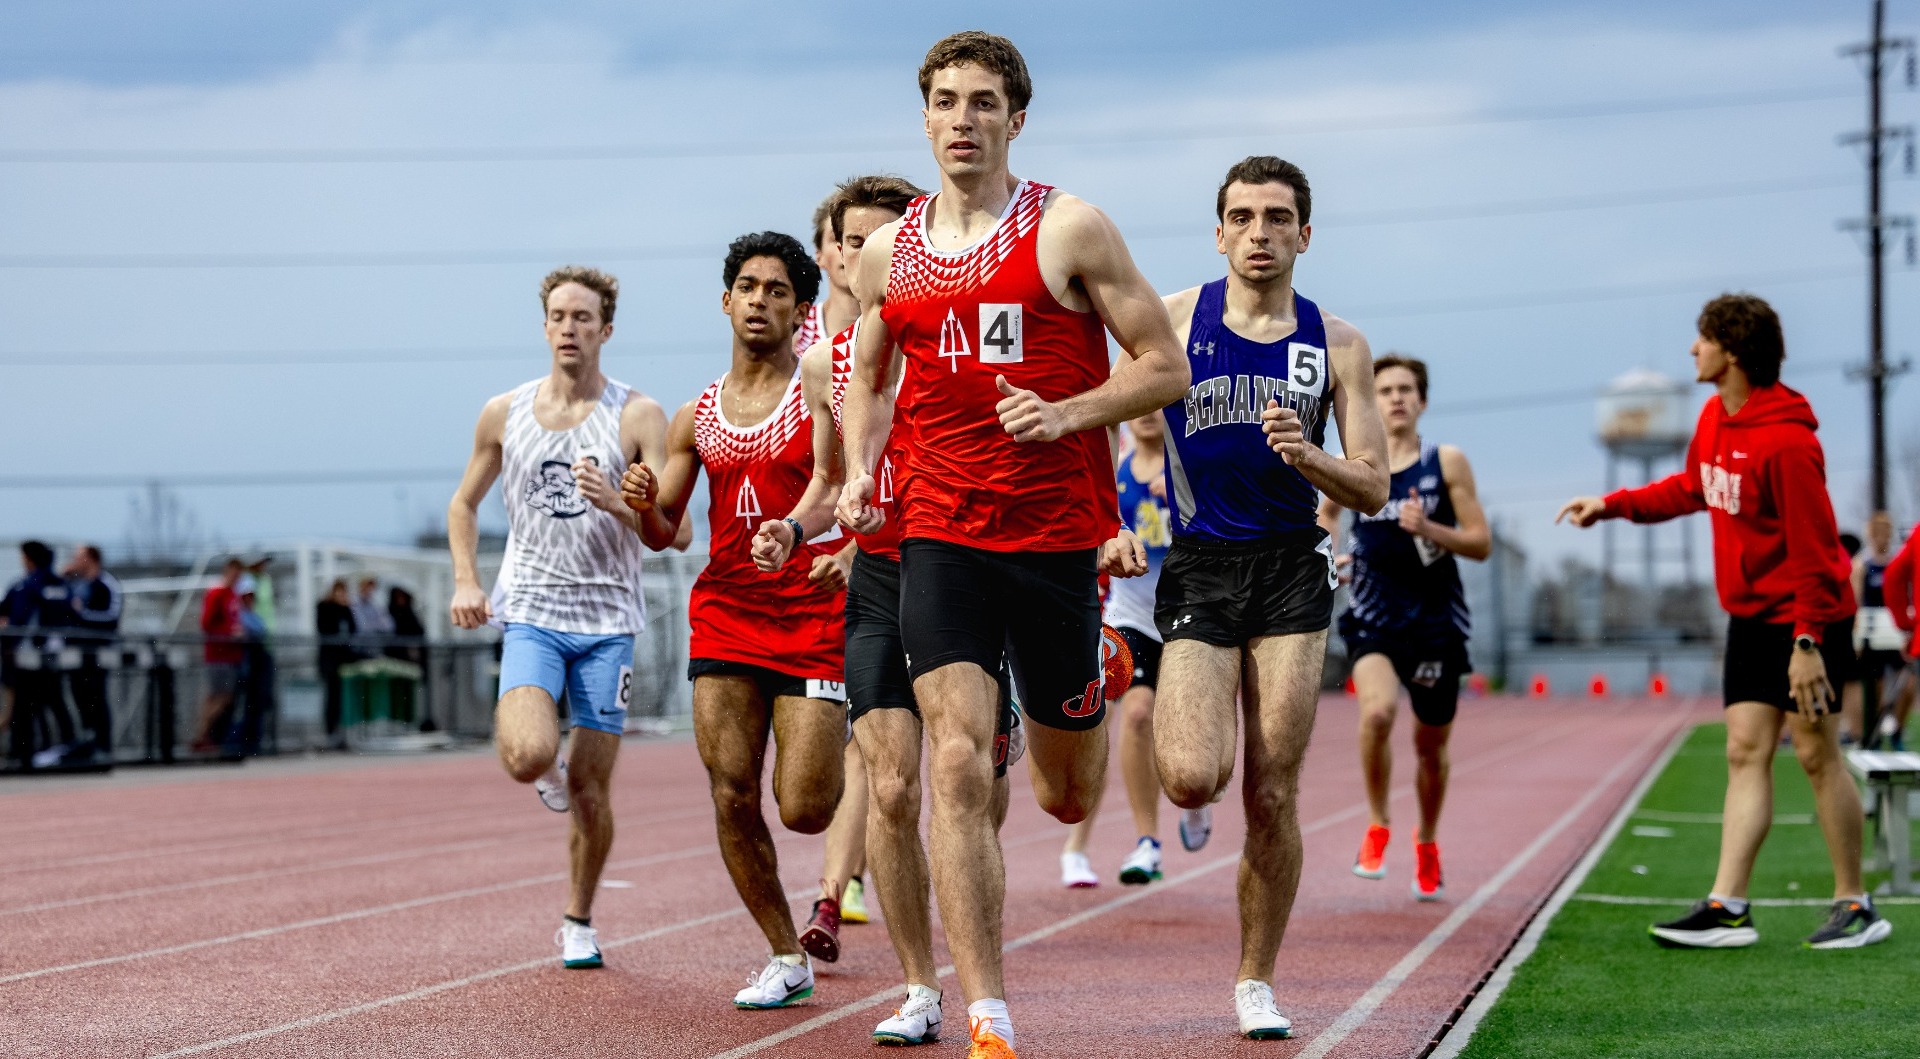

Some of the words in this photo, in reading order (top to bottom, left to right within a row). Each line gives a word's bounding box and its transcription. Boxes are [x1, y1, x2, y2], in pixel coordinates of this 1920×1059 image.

[984, 311, 1014, 354] 4
[1293, 350, 1318, 387] 5
[1184, 374, 1320, 441] SCRANTO
[621, 673, 631, 703] 8
